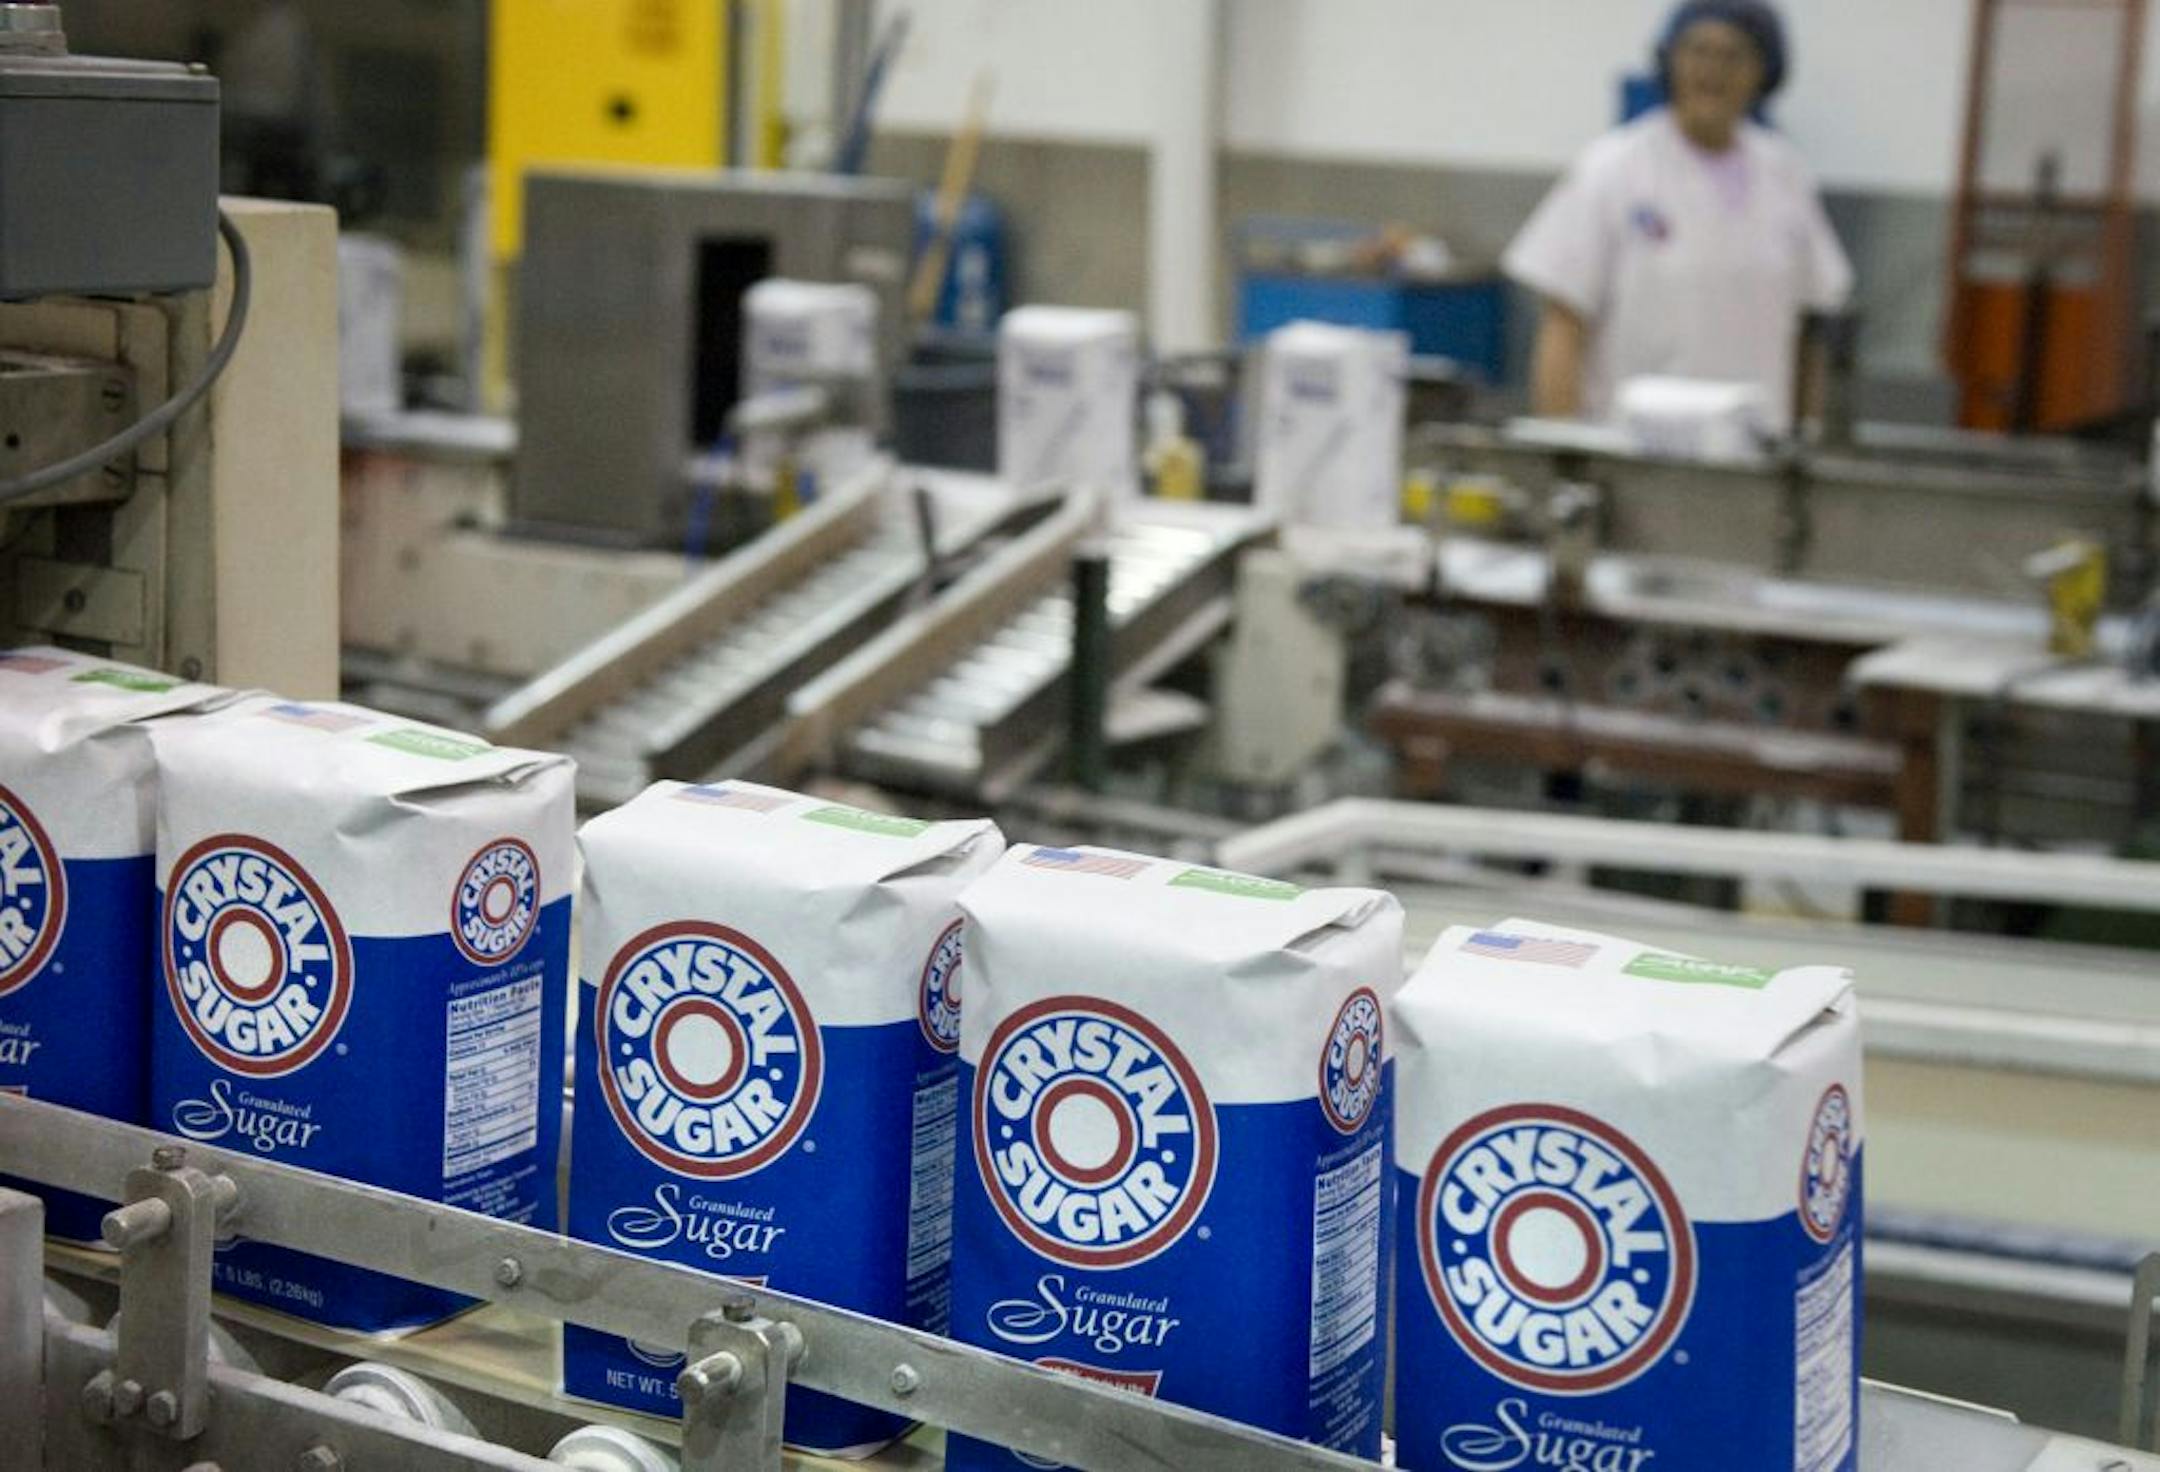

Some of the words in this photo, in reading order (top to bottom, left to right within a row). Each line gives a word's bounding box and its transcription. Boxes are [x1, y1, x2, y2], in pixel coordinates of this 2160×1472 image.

[174, 853, 329, 973] CRYSTAL
[463, 847, 534, 908] CRYSTAL
[463, 903, 531, 953] SUGAR
[178, 960, 319, 1055] SUGAR
[611, 941, 797, 1066] CRYSTAL
[171, 1078, 322, 1153] Sugar
[238, 1088, 311, 1119] Granulated
[614, 1056, 786, 1156] SUGAR
[990, 1019, 1190, 1149] CRYSTAL
[606, 1182, 785, 1259] Sugar
[688, 1194, 774, 1223] Granulated
[995, 1141, 1181, 1245] SUGAR
[1440, 1128, 1666, 1268] CRYSTAL
[985, 1274, 1181, 1353] Sugar
[1074, 1285, 1169, 1314] Granulated
[1447, 1264, 1653, 1368] SUGAR
[606, 1368, 636, 1390] NET
[638, 1375, 666, 1397] WT.
[1440, 1397, 1655, 1472] Sugar
[1537, 1411, 1641, 1443] Granulated
